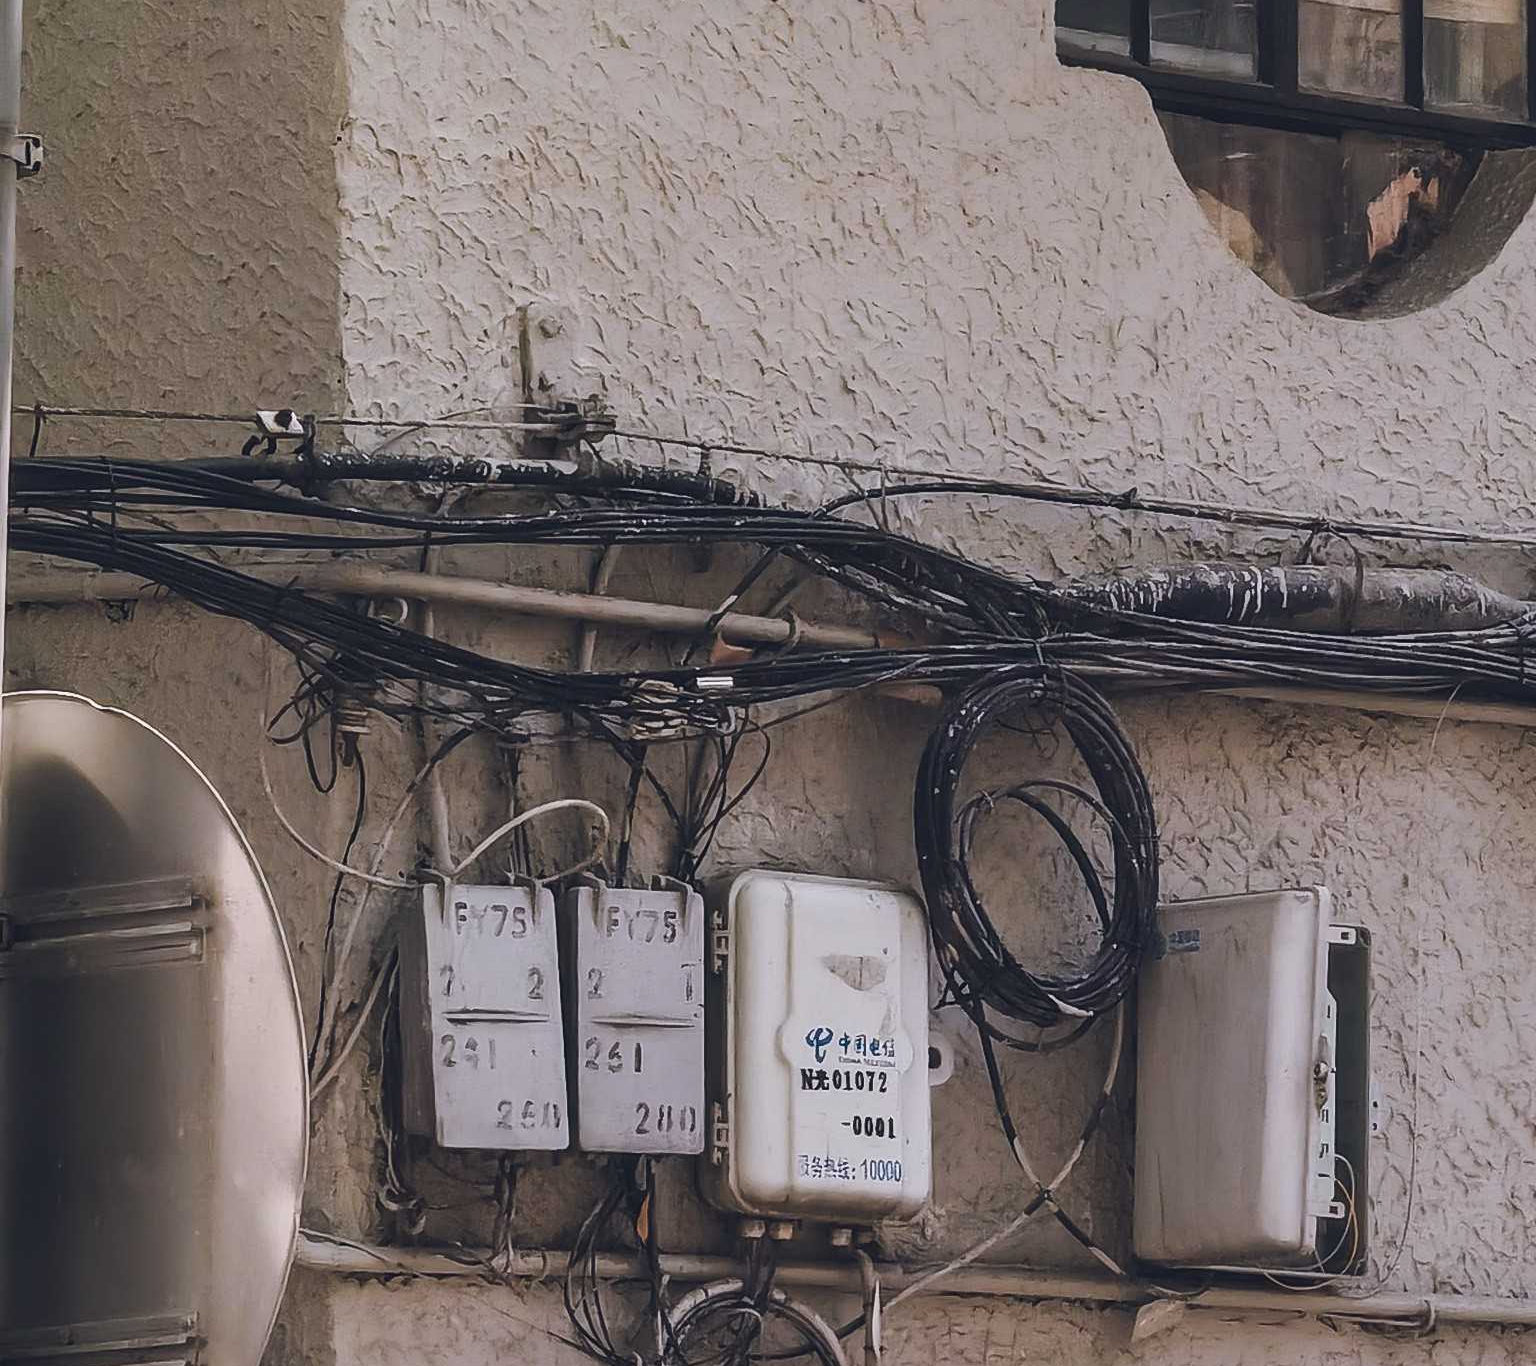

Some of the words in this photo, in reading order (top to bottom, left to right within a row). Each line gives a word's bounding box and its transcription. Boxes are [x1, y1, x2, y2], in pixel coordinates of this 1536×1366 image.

[528, 967, 544, 1000] 2
[838, 1032, 895, 1057] 中国电信
[860, 1159, 902, 1182] 10000
